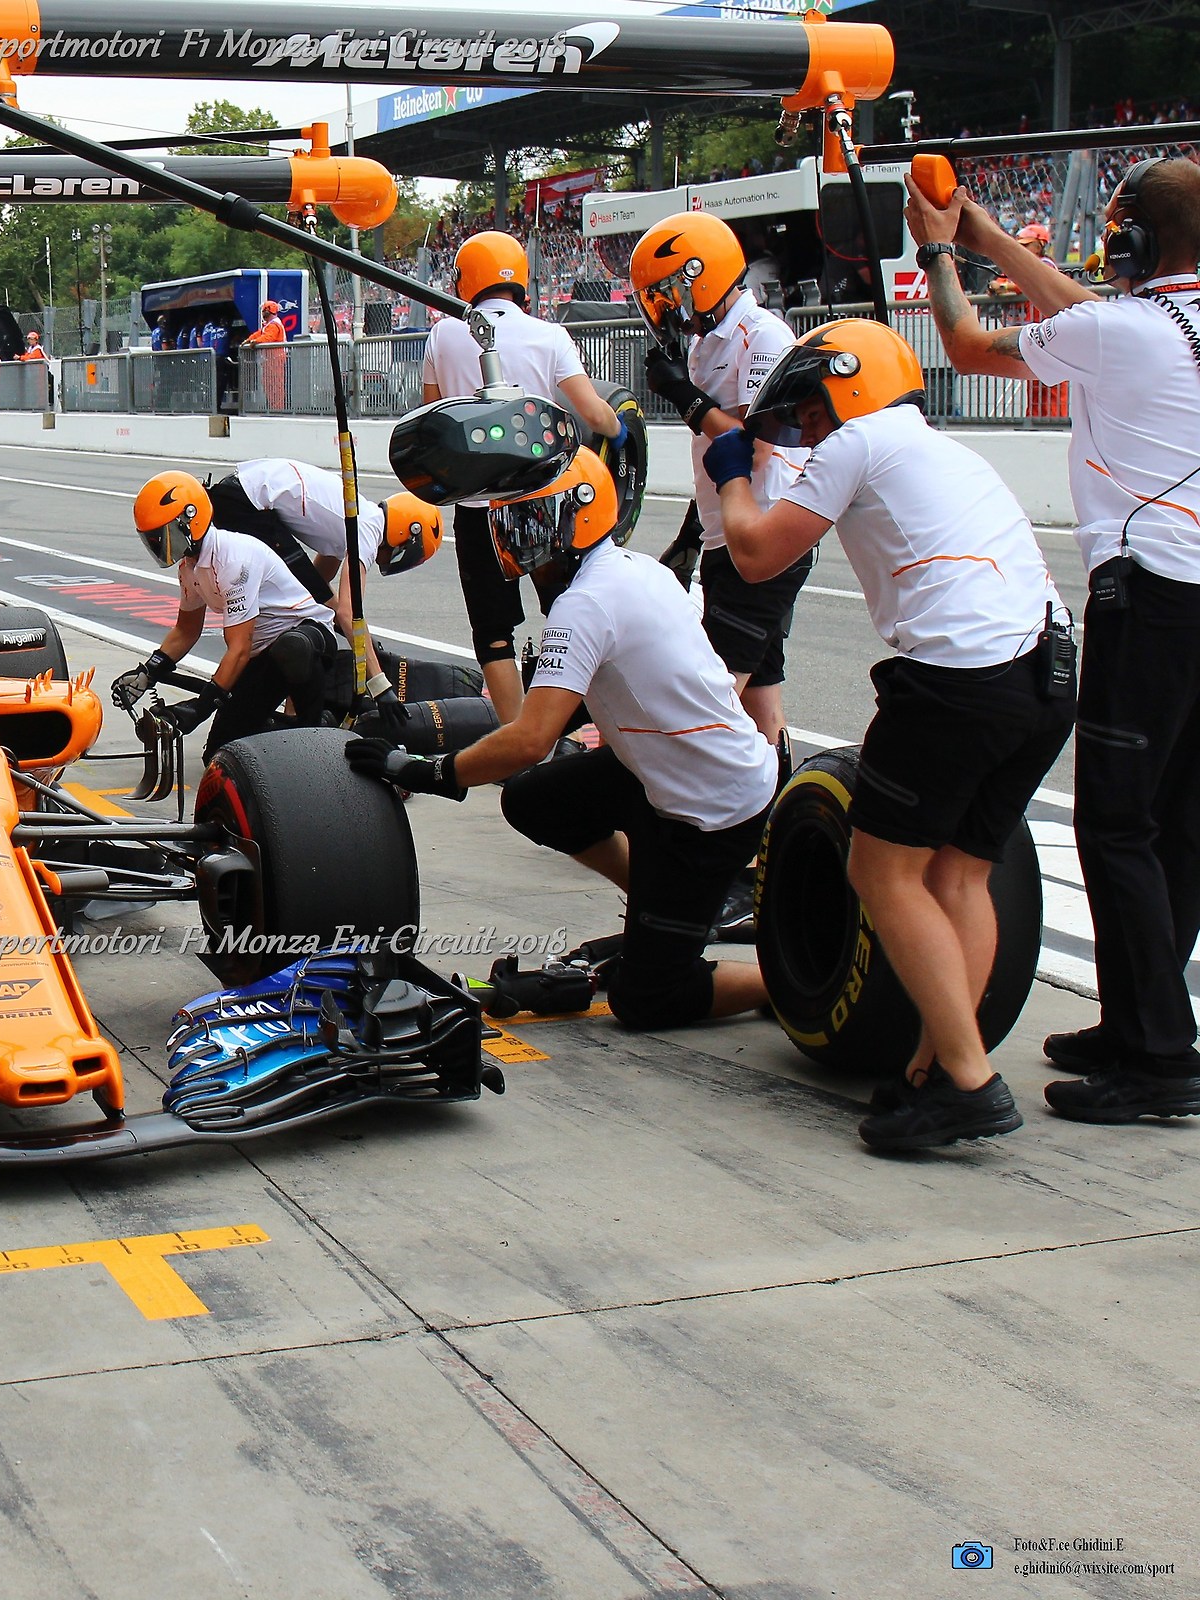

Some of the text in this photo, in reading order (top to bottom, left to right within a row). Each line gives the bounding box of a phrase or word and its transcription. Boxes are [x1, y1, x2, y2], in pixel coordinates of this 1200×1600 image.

[252, 33, 582, 74] McLaren
[393, 89, 442, 121] Heineken
[866, 165, 901, 173] F1 Team
[705, 191, 780, 209] Haas Automation Inc.
[620, 210, 636, 221] Team
[3, 632, 36, 647] Airgain
[543, 630, 568, 638] Hilton
[538, 657, 565, 669] DELL
[398, 660, 408, 703] ERNANDO
[60, 1256, 84, 1264] 10
[173, 1242, 200, 1252] 10
